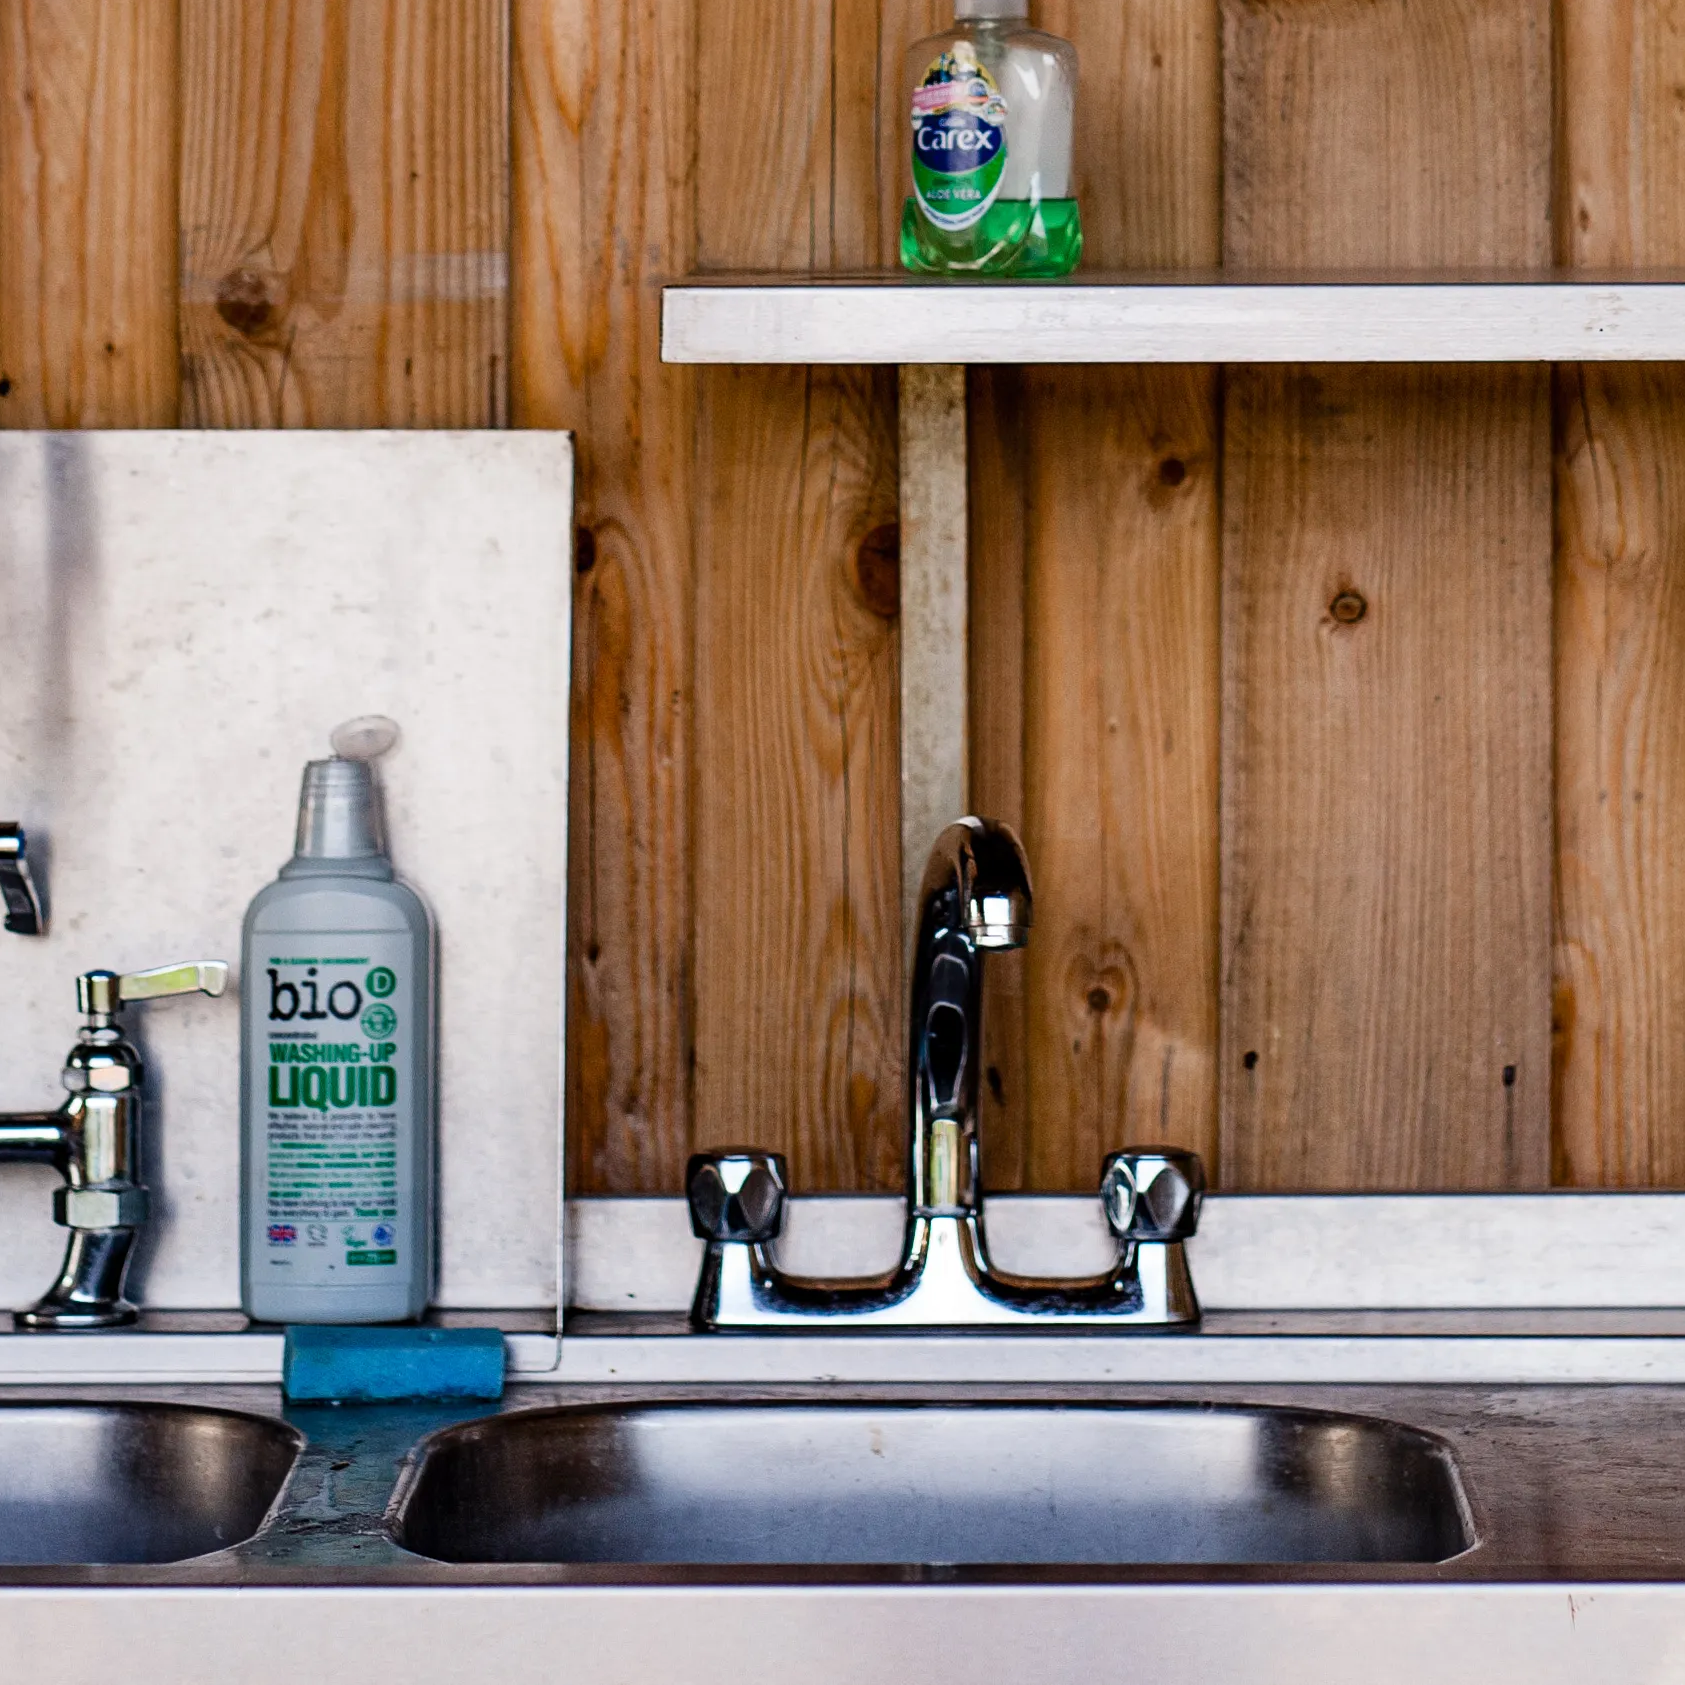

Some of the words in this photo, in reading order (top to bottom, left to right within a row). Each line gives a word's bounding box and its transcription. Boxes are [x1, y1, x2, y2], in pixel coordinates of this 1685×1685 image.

[918, 126, 993, 151] Carex
[266, 967, 363, 1021] bio
[268, 1042, 397, 1063] WASHING-UP
[268, 1065, 397, 1113] LIQUID
